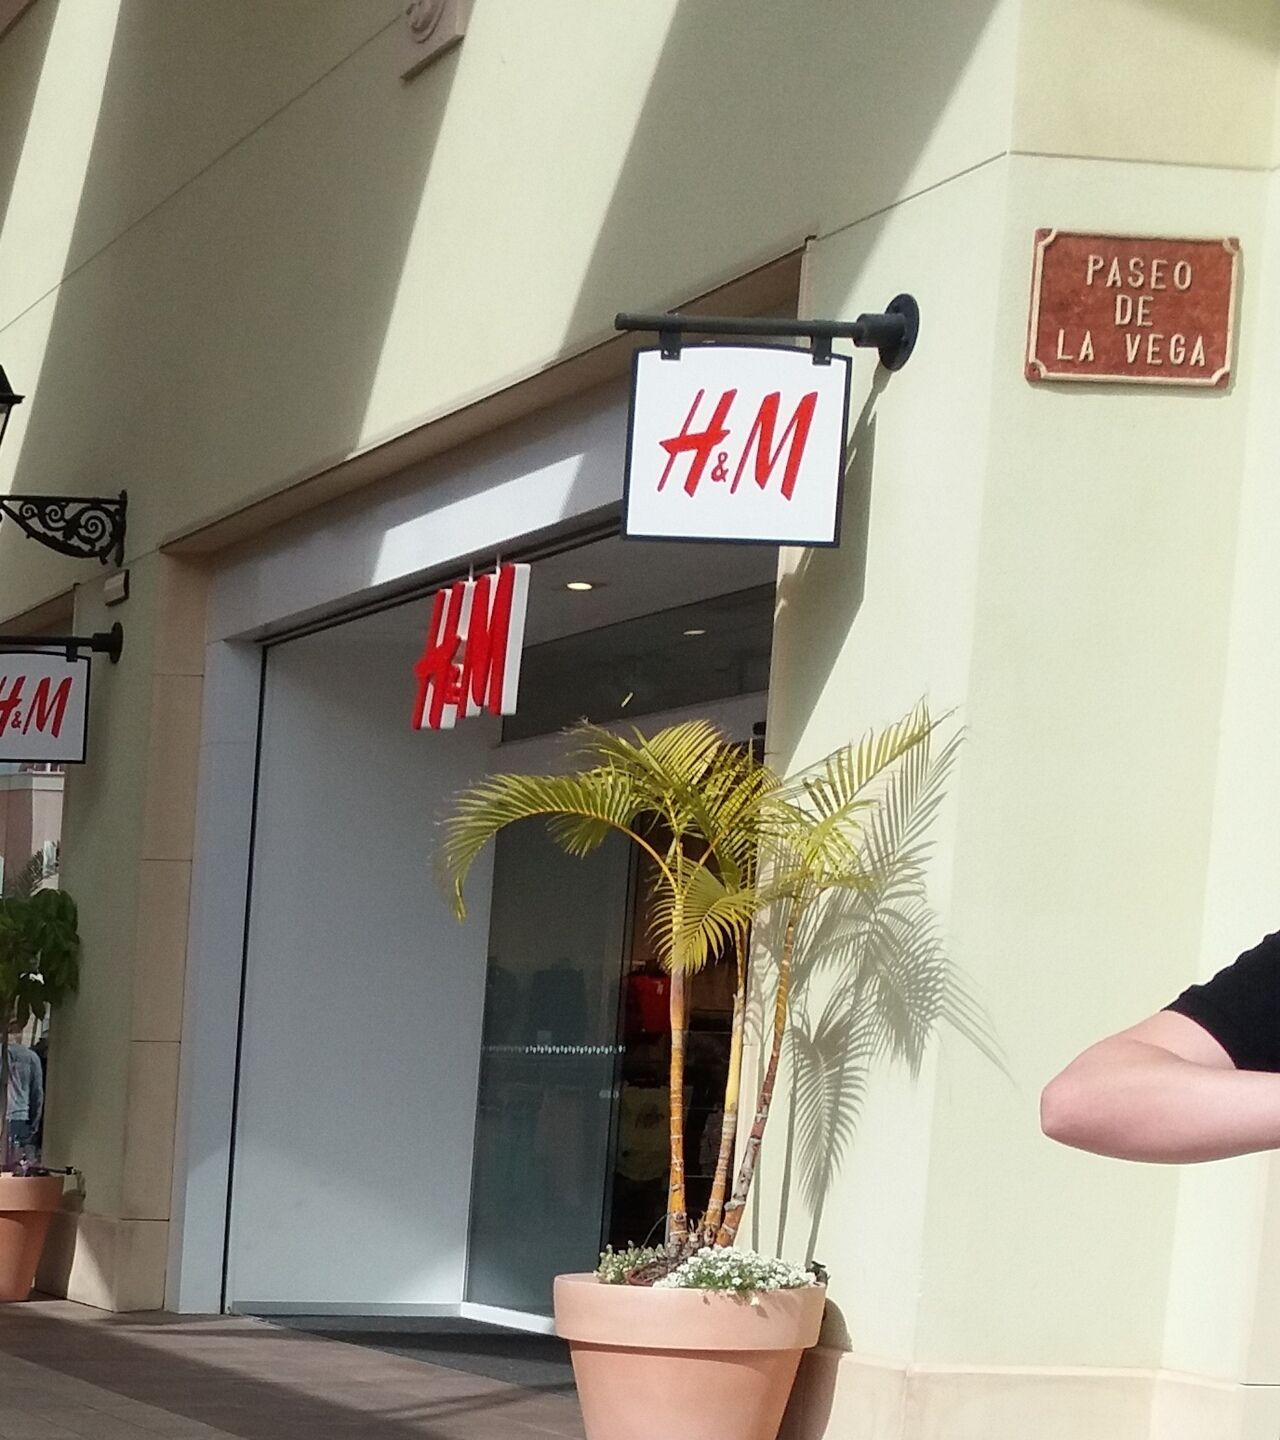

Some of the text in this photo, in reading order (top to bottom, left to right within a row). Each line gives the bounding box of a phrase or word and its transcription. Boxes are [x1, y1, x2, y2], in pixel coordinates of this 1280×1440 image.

[1085, 253, 1193, 291] PASEO
[1114, 293, 1156, 328] DE
[1056, 327, 1207, 368] LA VEGA
[657, 387, 819, 502] H&M
[412, 562, 520, 731] H&M
